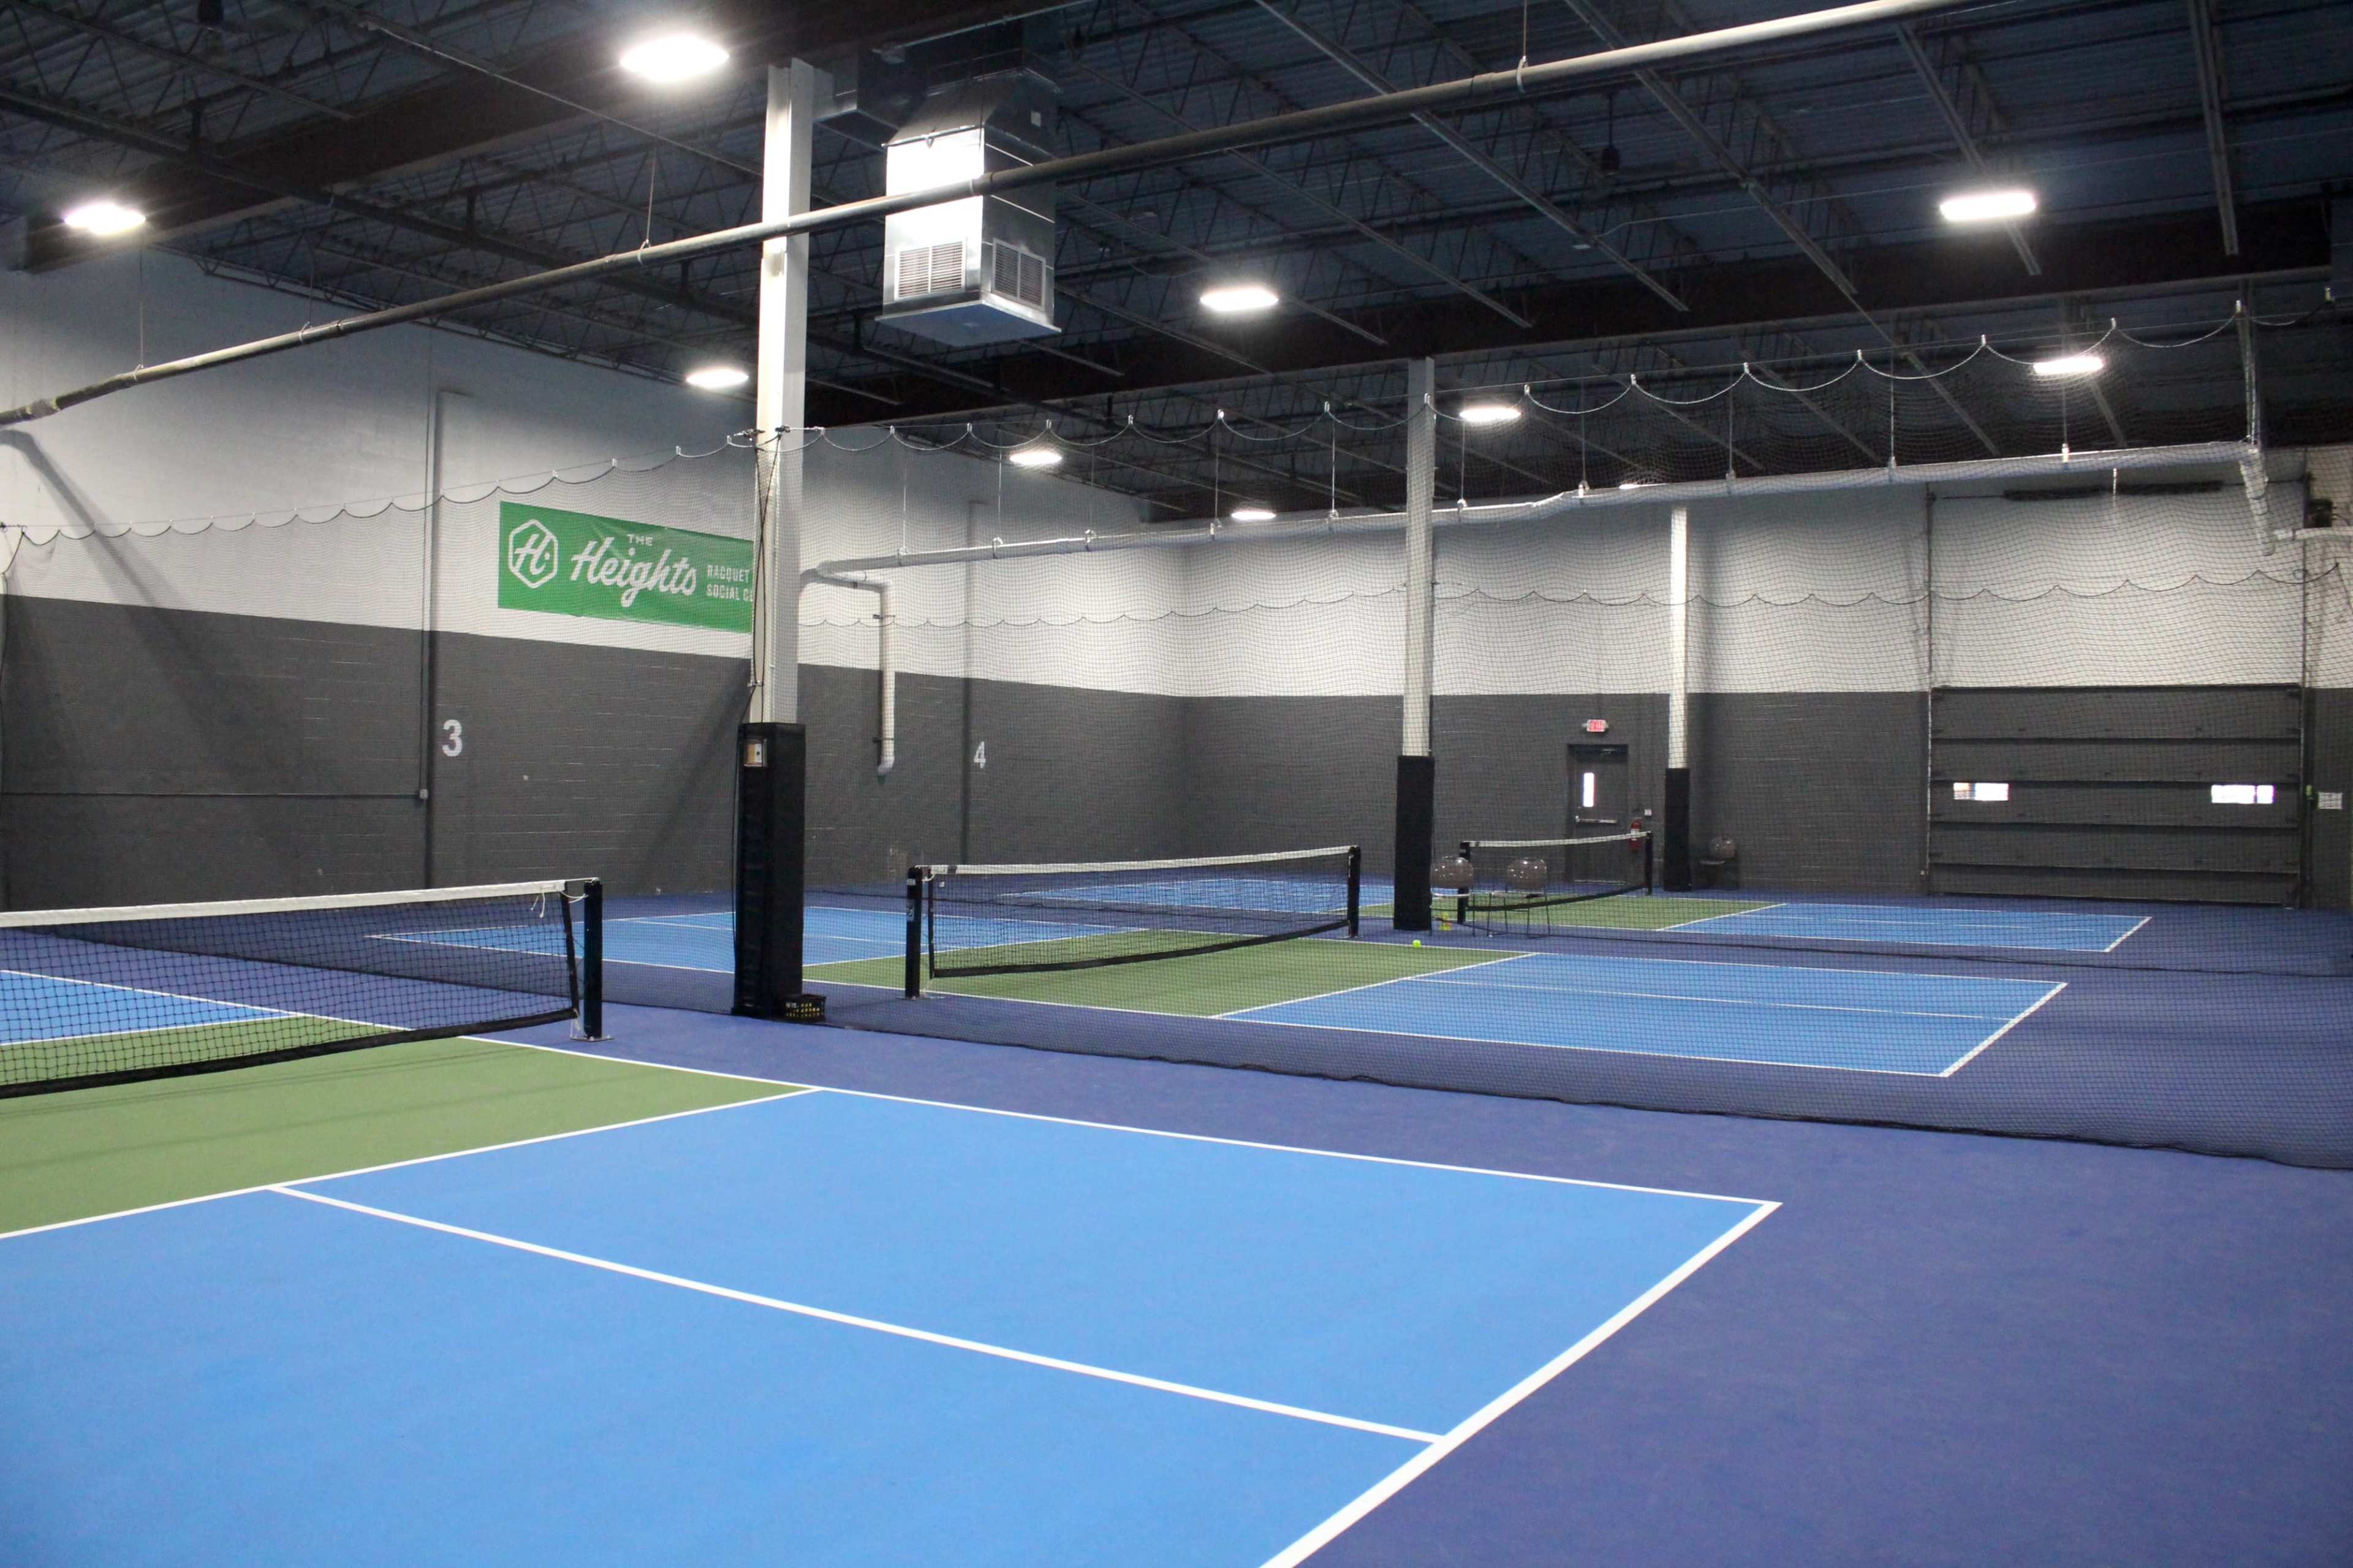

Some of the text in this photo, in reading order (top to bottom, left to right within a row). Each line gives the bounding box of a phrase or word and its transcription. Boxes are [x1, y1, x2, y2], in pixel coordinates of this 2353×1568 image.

[627, 534, 653, 546] THE
[570, 537, 697, 608] Heights
[707, 564, 749, 583] RACQUET
[706, 583, 740, 600] SOCIAL
[442, 719, 463, 757] 3
[973, 741, 986, 769] 4
